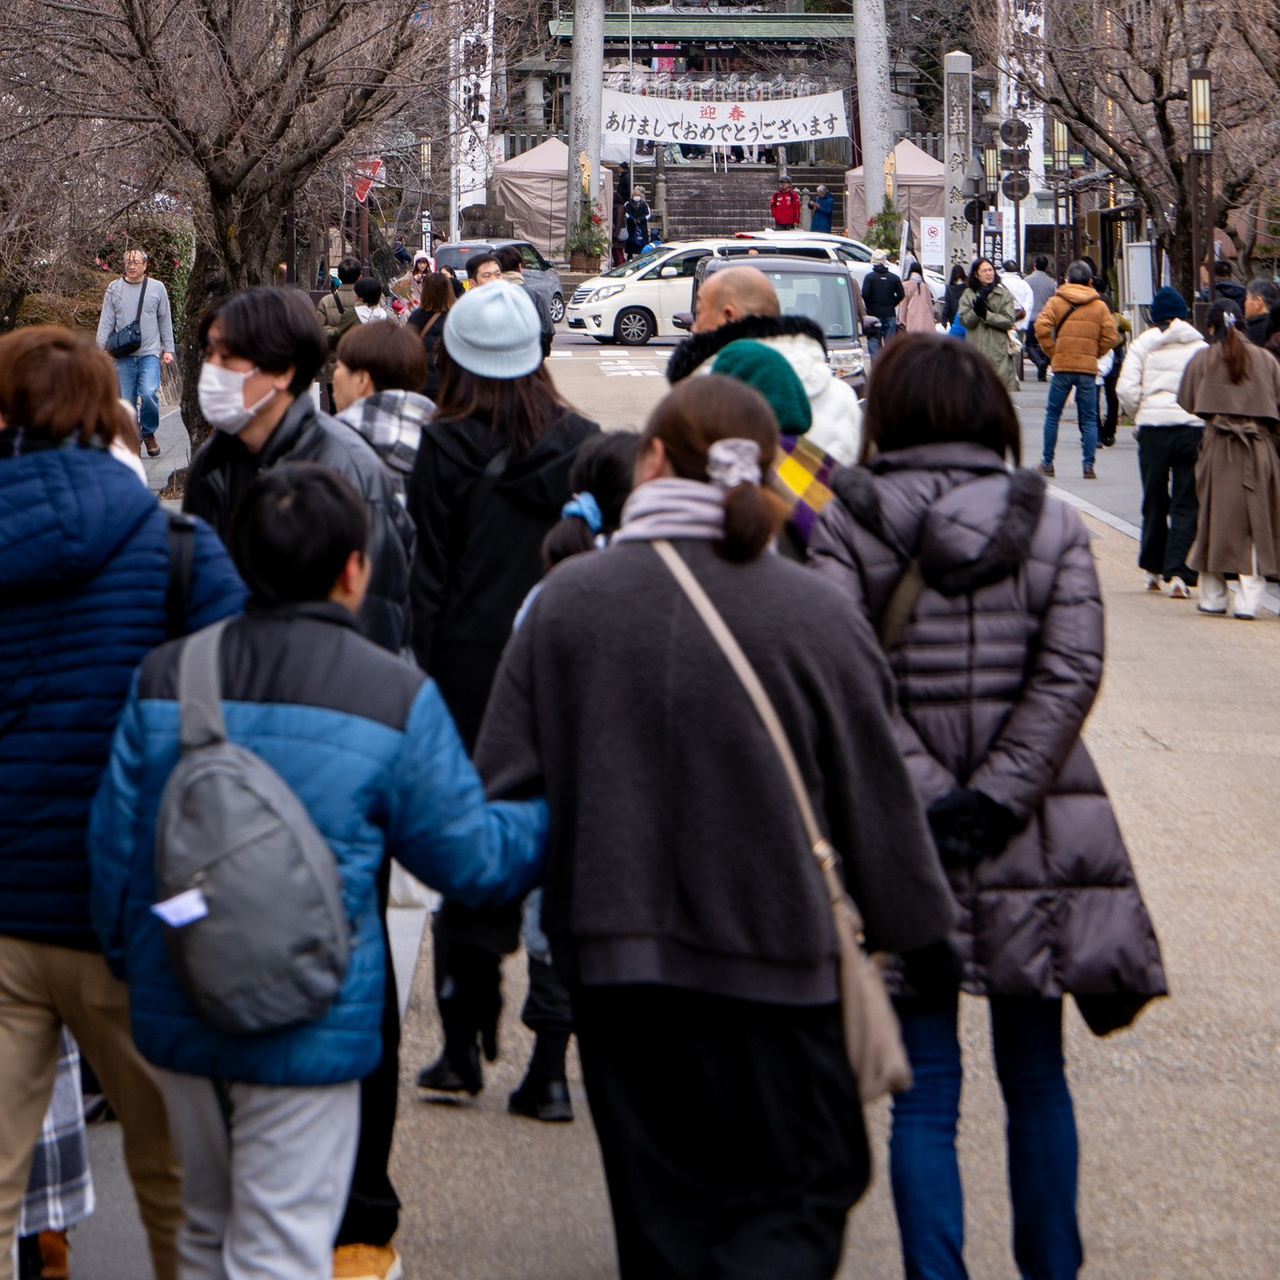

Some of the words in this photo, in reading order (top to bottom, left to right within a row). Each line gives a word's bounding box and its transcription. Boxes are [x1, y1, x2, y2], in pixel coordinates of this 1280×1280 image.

[699, 105, 746, 121] 迎春
[605, 113, 839, 143] あけましておめでとうございます
